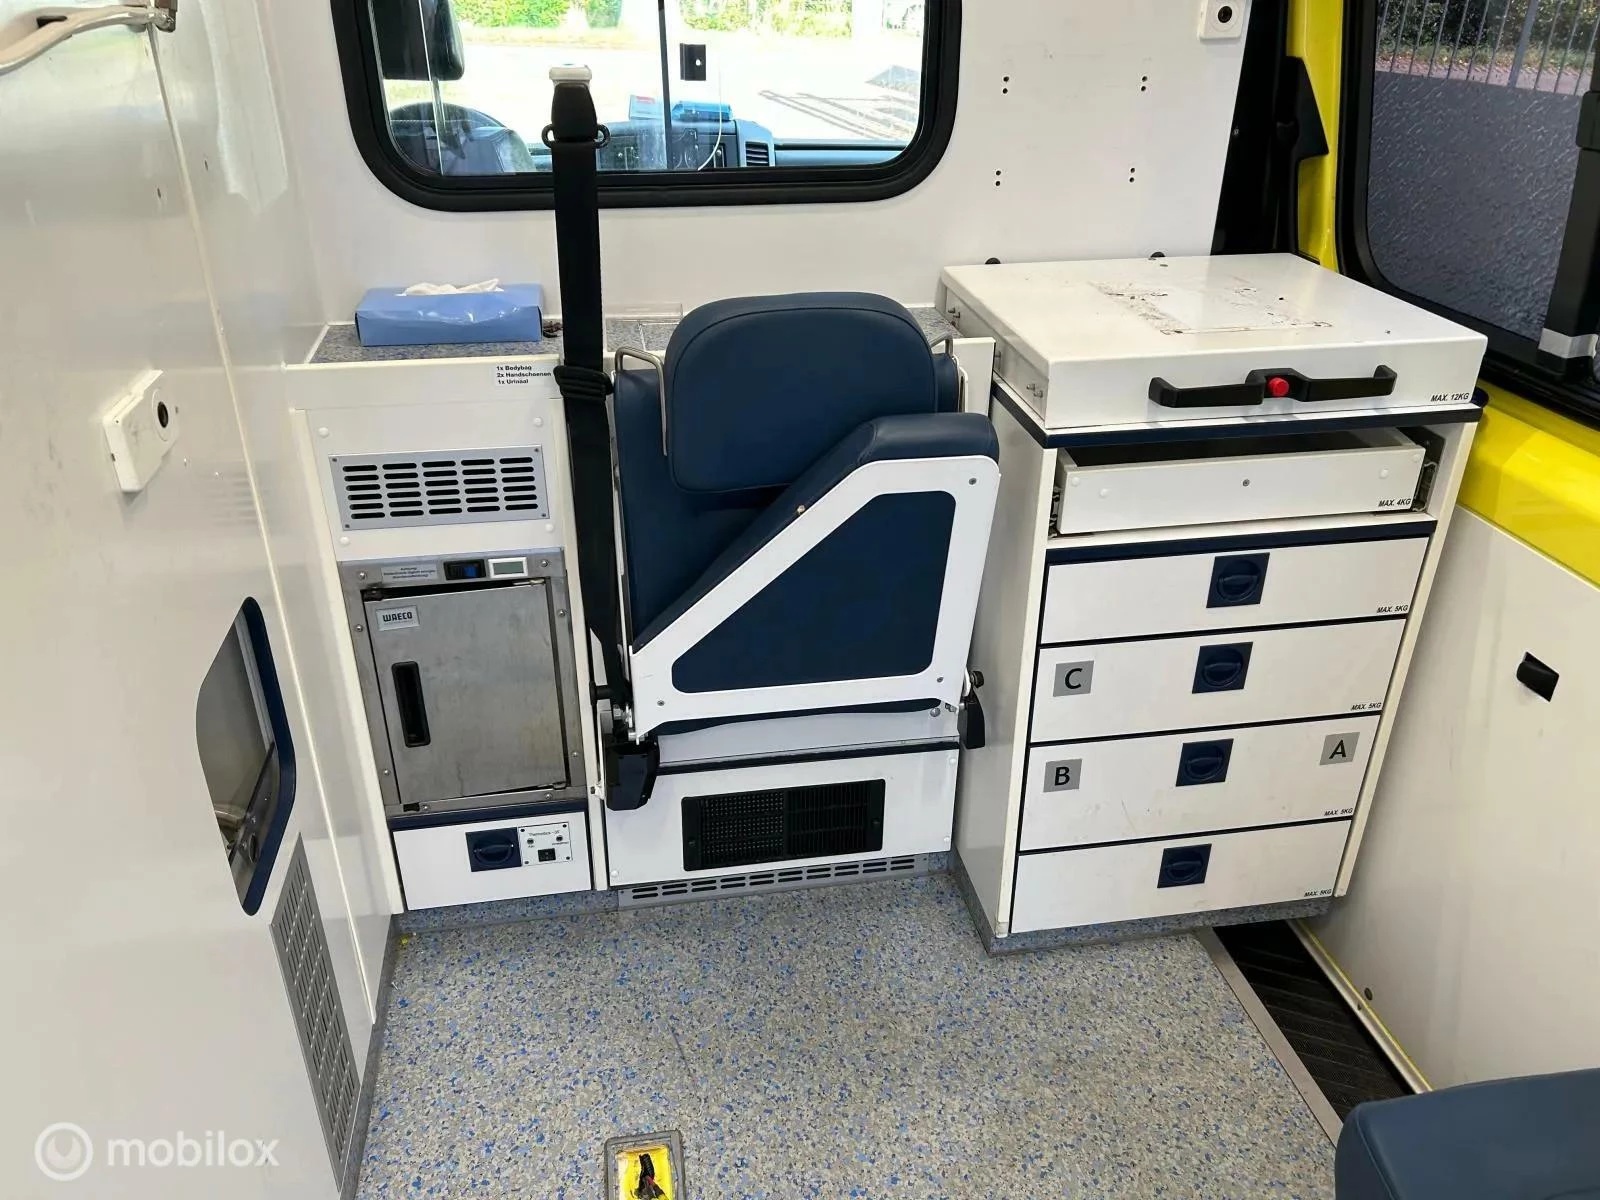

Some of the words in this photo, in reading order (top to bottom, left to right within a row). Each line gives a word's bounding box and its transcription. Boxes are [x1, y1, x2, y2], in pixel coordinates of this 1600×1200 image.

[1430, 393, 1448, 402] MAX.
[1450, 392, 1470, 401] 12KG
[1378, 499, 1395, 507] MAX.
[1396, 498, 1412, 506] 4KG
[1394, 604, 1409, 612] 5KG
[382, 611, 413, 622] WAECO
[1064, 667, 1083, 690] C
[1328, 739, 1347, 760] A
[1054, 766, 1071, 787] B
